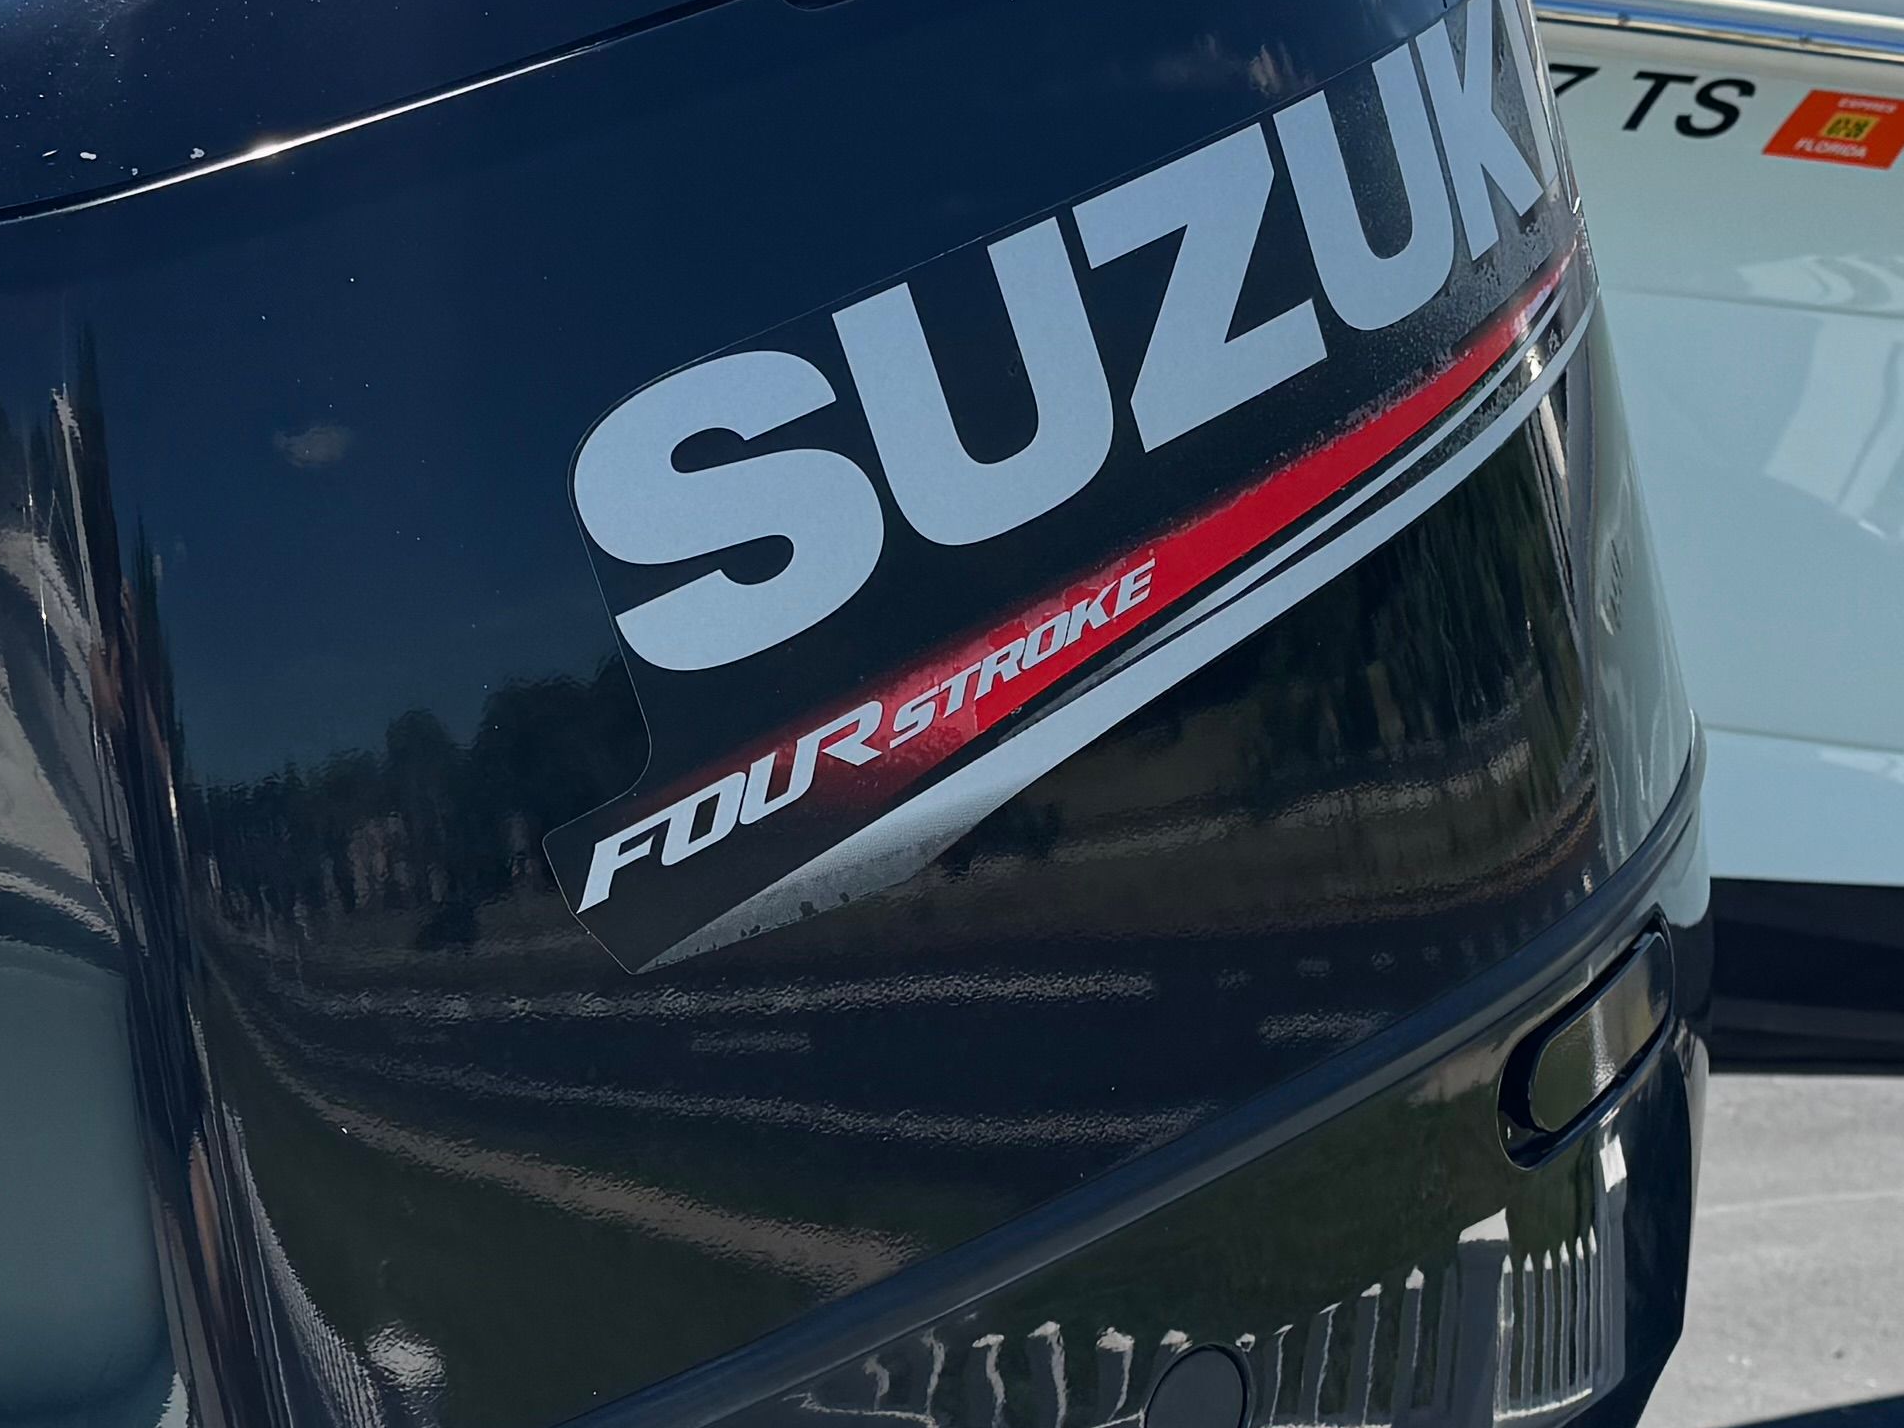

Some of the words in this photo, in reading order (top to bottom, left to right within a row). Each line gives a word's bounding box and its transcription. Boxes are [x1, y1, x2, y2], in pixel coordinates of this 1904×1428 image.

[1622, 70, 1756, 139] TS
[576, 700, 883, 914] FOUR
[889, 558, 1156, 749] STROKE
